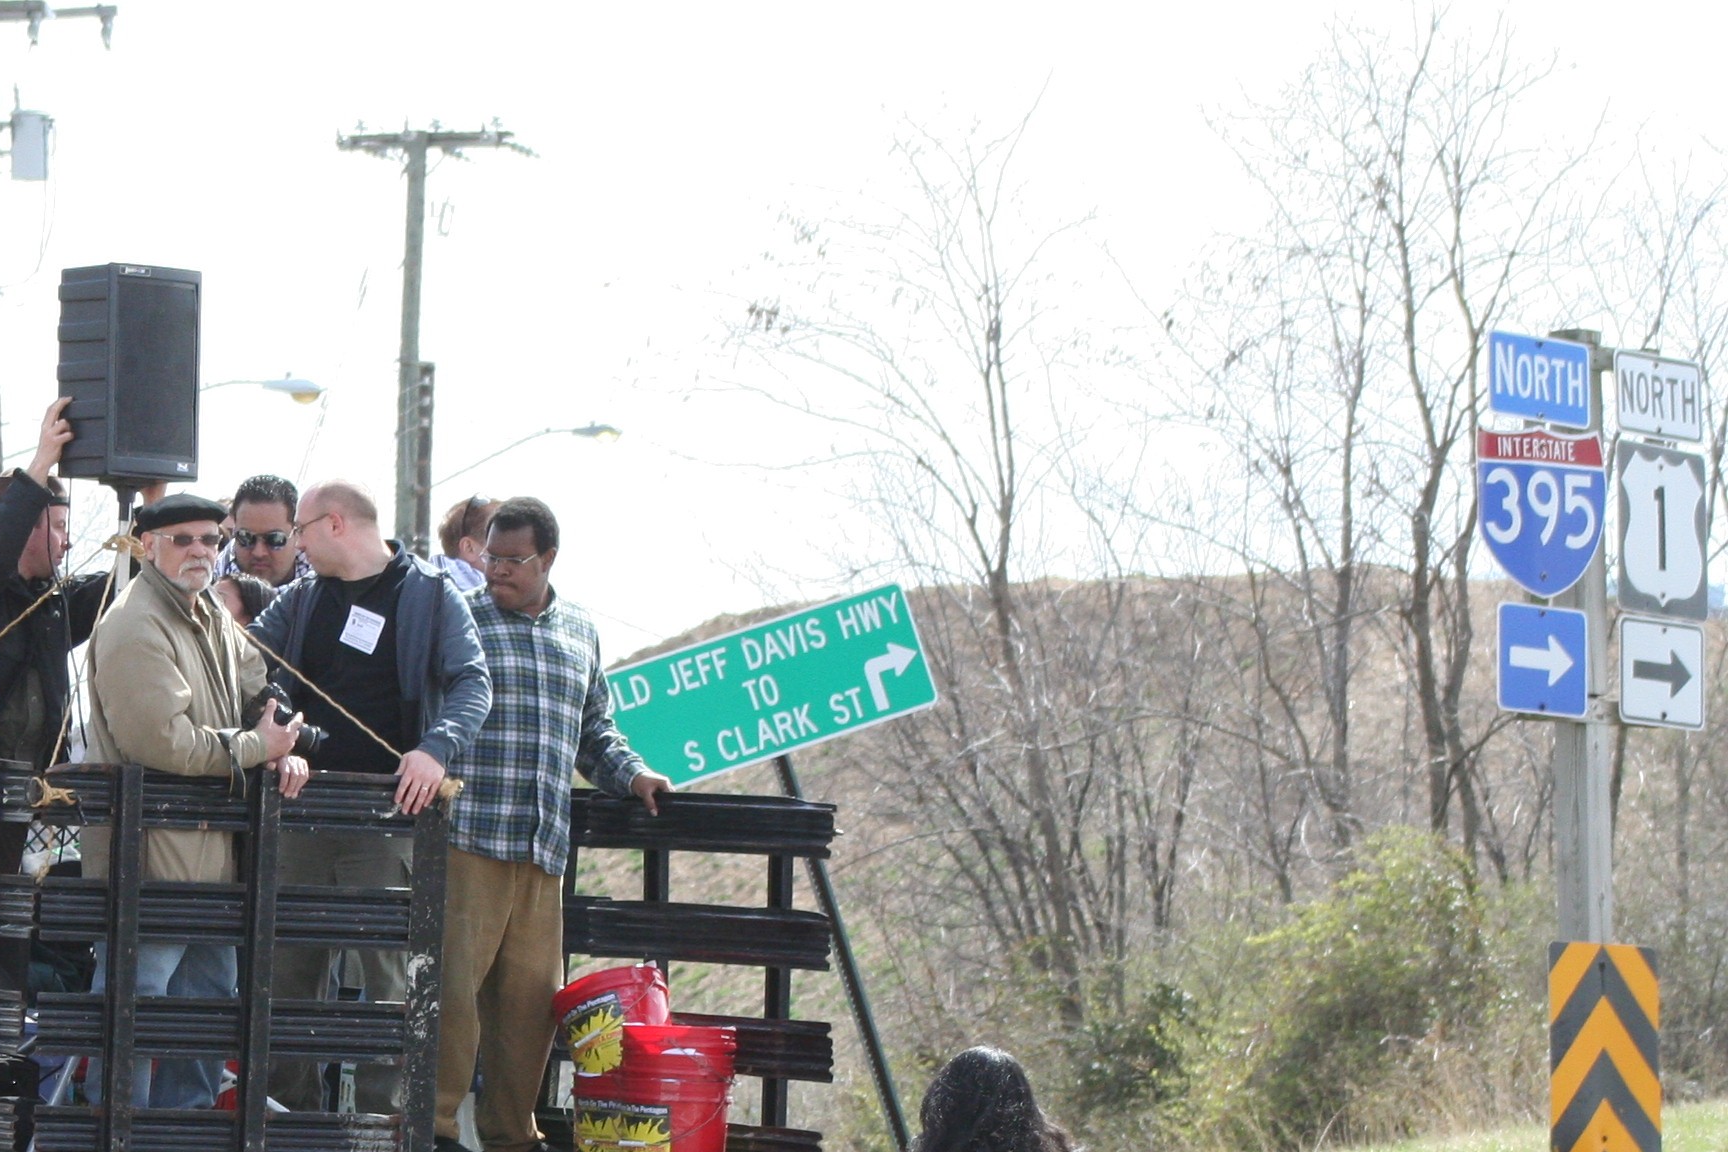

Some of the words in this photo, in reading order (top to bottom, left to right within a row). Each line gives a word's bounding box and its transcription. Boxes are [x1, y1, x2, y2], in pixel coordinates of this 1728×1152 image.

[1494, 341, 1584, 408] NORTH
[1620, 368, 1697, 426] NORTH
[1497, 436, 1575, 462] INTERSTATE
[1484, 466, 1596, 550] 395
[1653, 485, 1667, 572] 1
[666, 647, 727, 697] JEFF
[741, 618, 827, 671] DAVIS
[836, 592, 900, 639] HWY
[684, 740, 706, 773] S
[717, 704, 819, 762] CLARK
[829, 687, 866, 725] ST
[742, 674, 781, 711] TO
